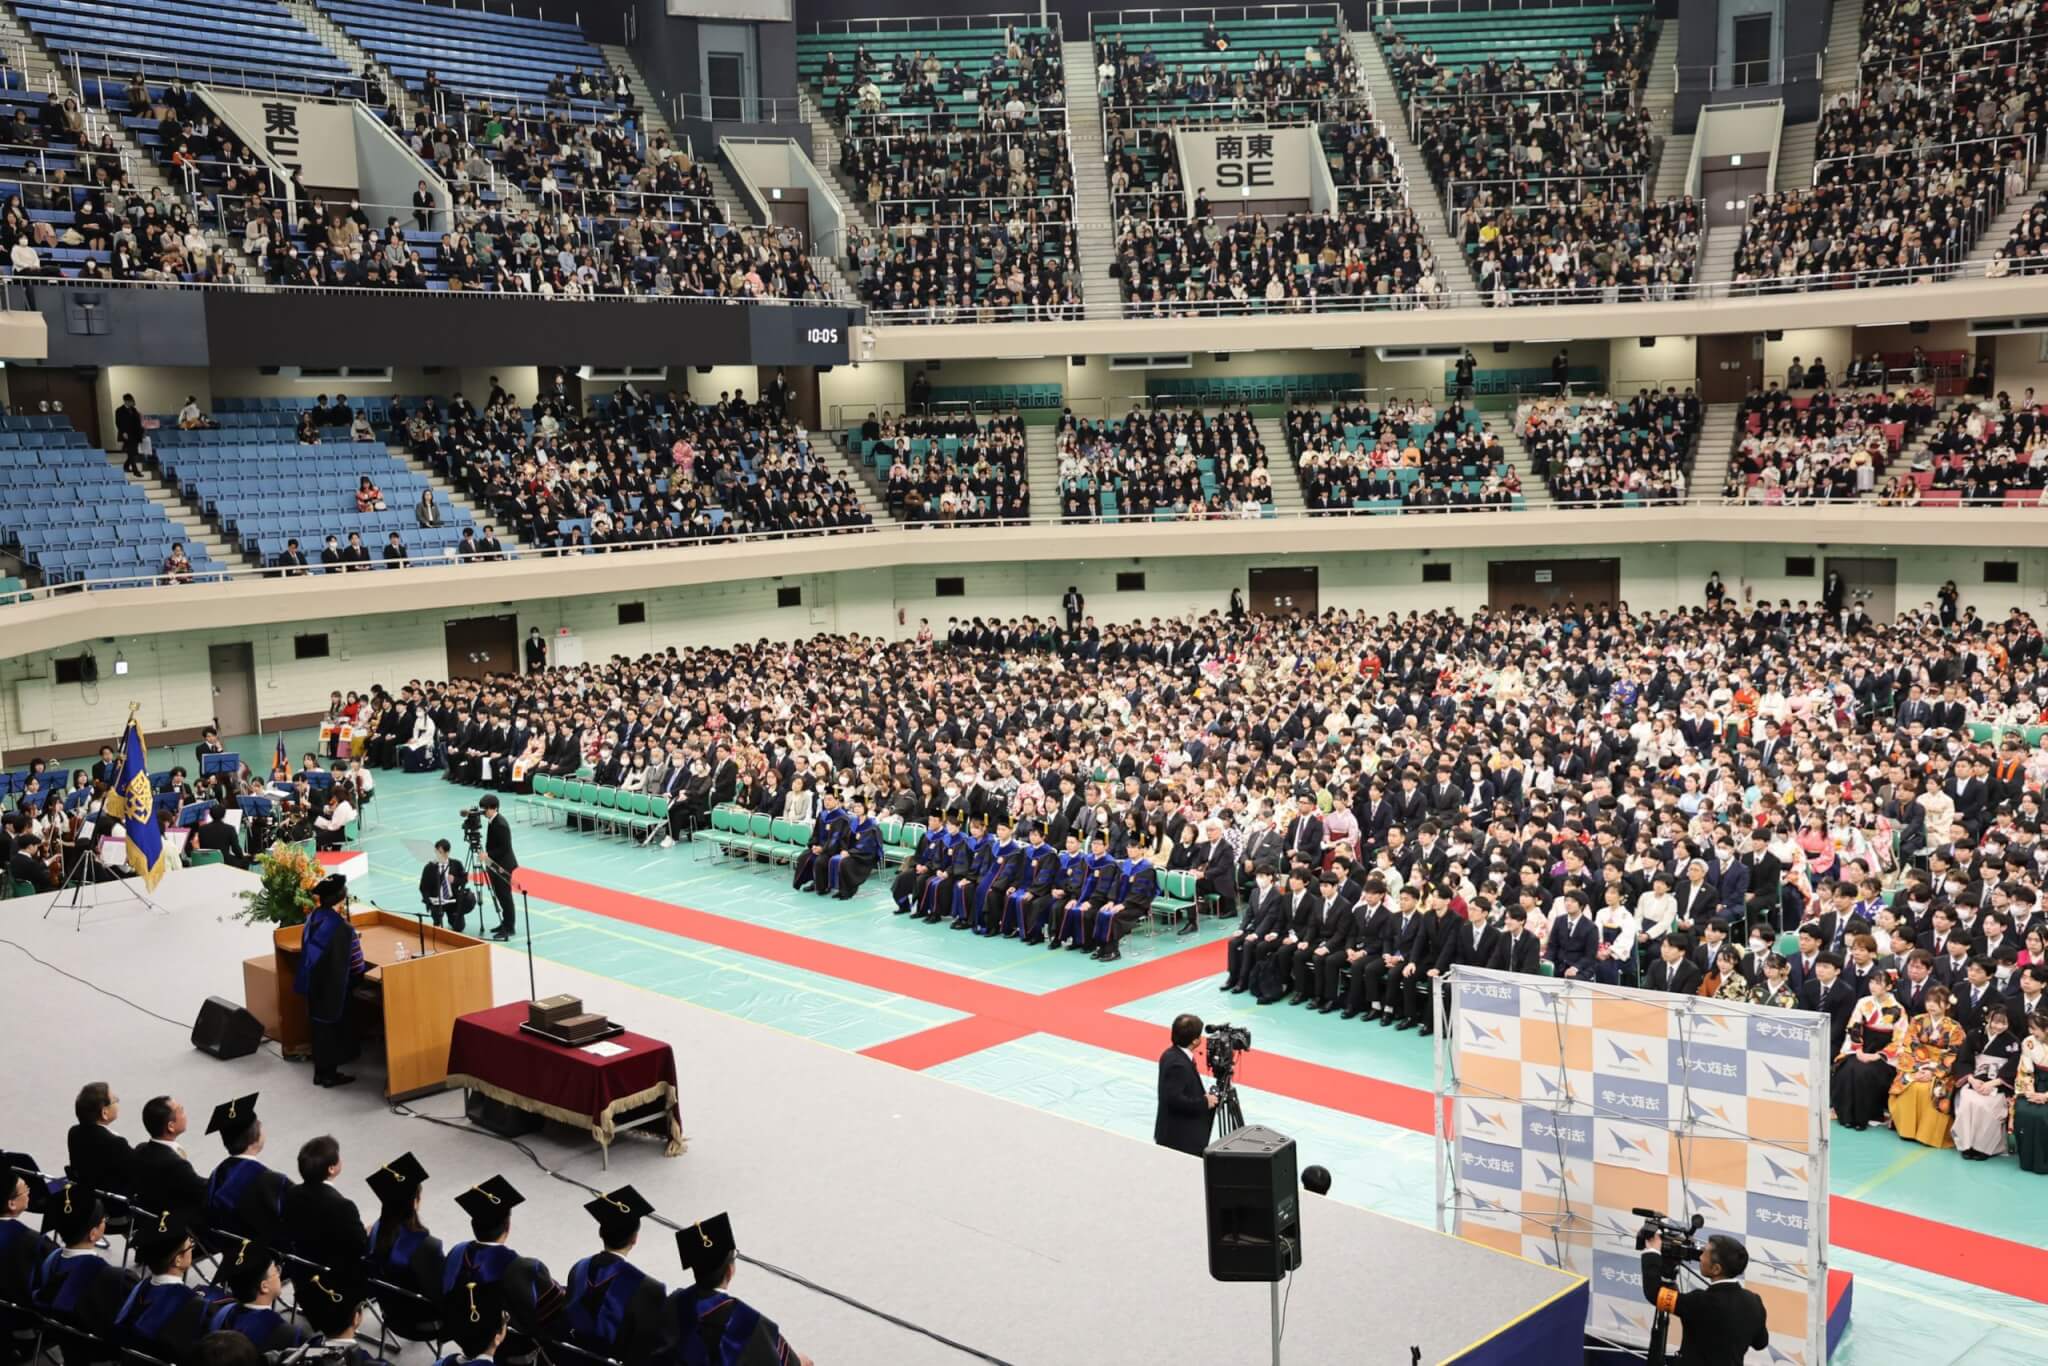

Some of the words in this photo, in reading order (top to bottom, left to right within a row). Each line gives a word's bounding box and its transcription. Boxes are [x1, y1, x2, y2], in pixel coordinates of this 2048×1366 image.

[262, 103, 299, 136] 東
[1216, 134, 1274, 160] 南東
[1216, 162, 1274, 188] SE
[808, 328, 838, 343] 10:05
